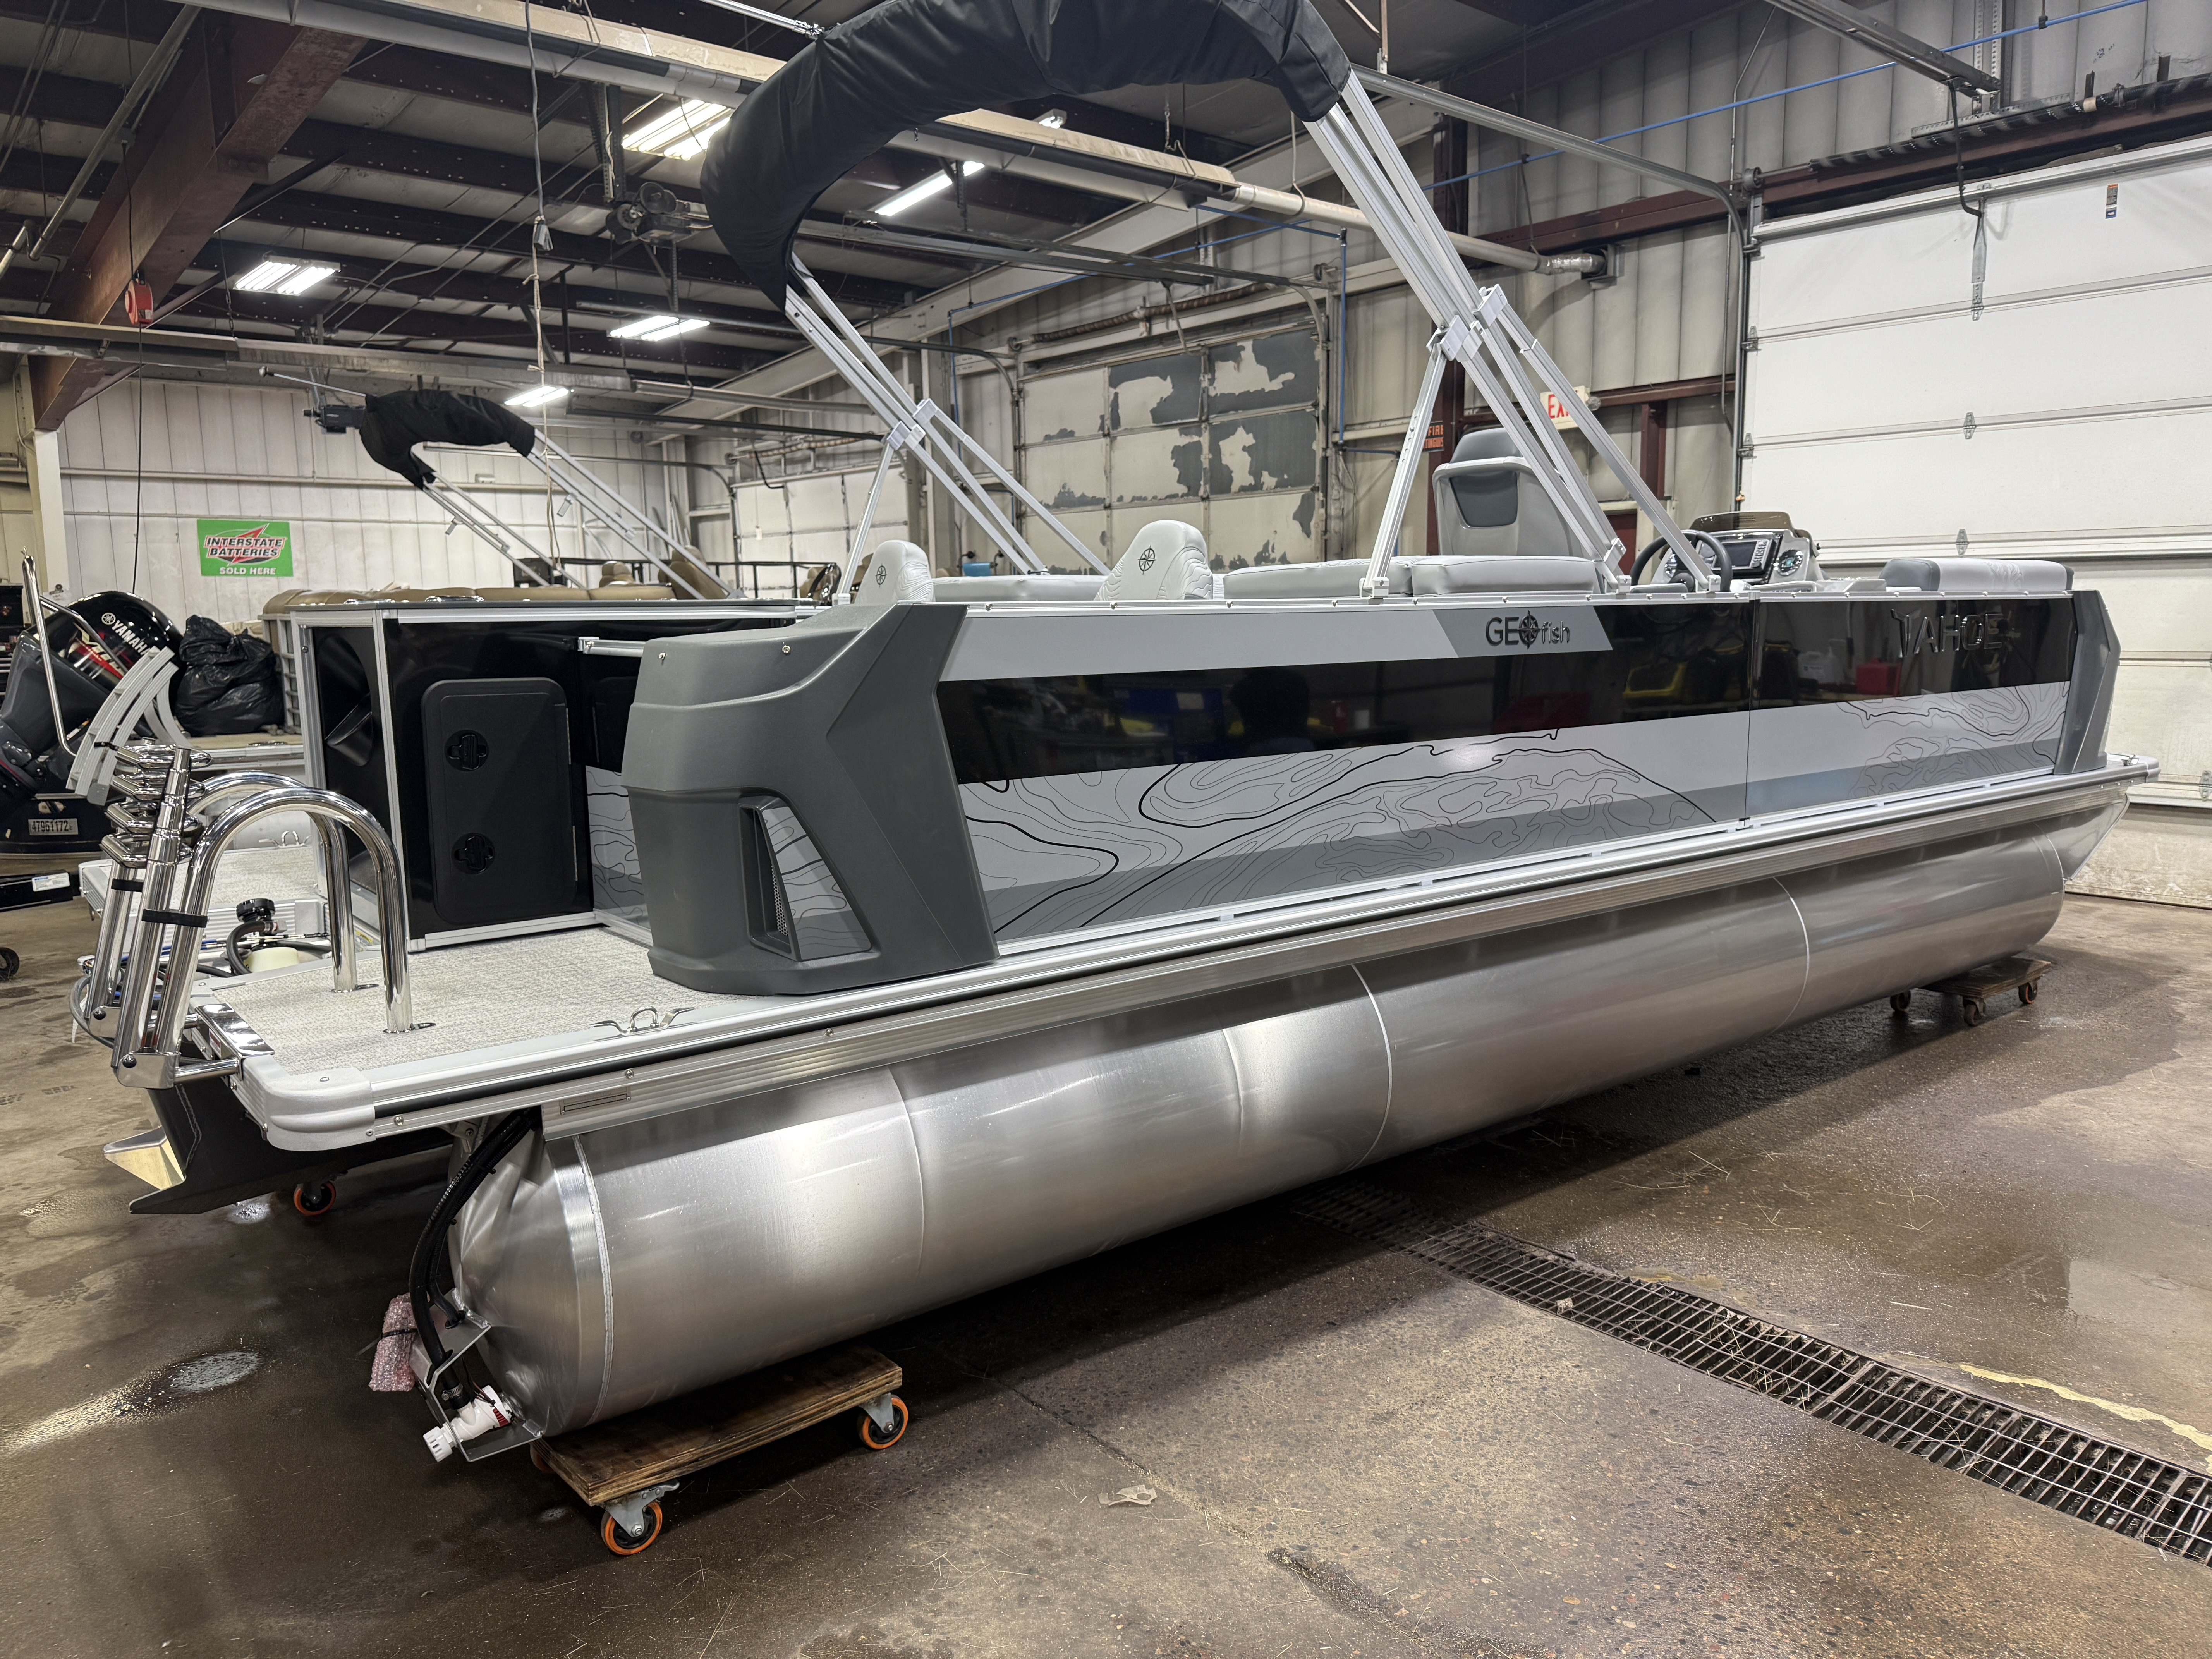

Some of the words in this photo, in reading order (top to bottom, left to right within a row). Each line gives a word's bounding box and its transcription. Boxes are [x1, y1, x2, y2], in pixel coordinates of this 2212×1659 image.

[1548, 394, 1569, 419] EX
[206, 537, 283, 547] INTERSTATE
[1891, 609, 2003, 658] TAHOE
